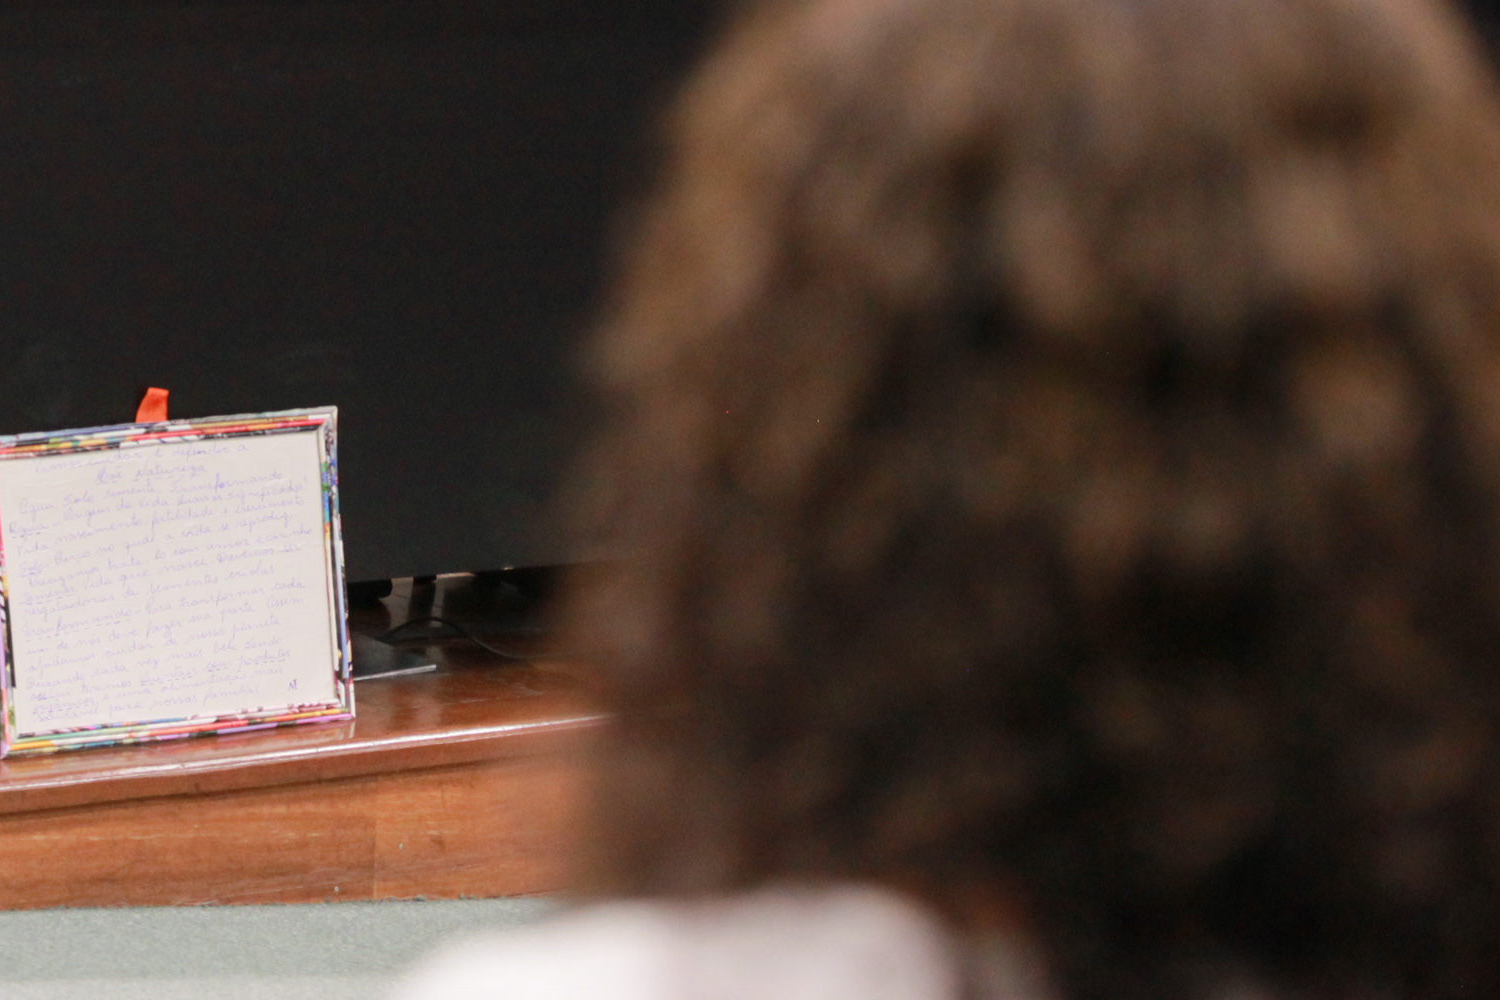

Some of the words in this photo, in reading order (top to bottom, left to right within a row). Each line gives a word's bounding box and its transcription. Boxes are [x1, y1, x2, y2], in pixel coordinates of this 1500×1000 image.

[172, 444, 229, 461] defender
[135, 459, 207, 480] Natureza
[235, 493, 305, 514] crescimento
[206, 538, 251, 551] amor
[179, 588, 265, 608] transformar
[270, 577, 307, 591] cada
[103, 640, 154, 659] cuidar
[231, 612, 281, 642] planeta
[108, 627, 139, 642] deve
[145, 619, 183, 641] fazer
